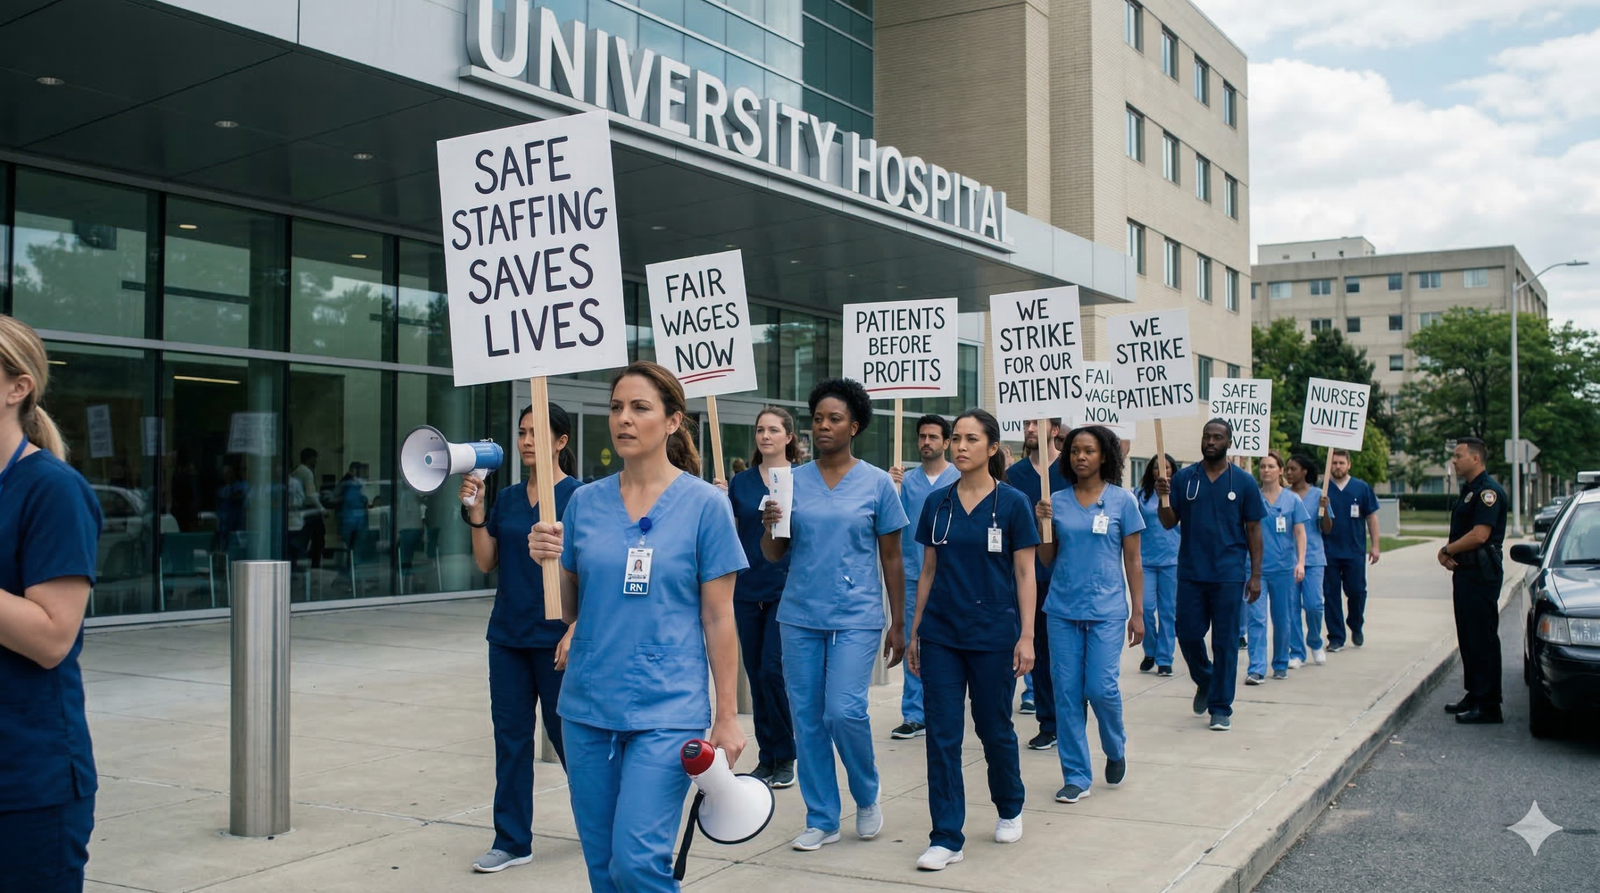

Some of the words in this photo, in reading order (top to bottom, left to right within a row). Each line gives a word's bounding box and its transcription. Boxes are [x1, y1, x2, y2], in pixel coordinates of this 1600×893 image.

[467, 0, 836, 182] UNIVERSITY
[848, 131, 1014, 245] HOSPITAL
[475, 136, 571, 195] SAFE
[452, 187, 607, 251] STAFFING
[469, 243, 594, 305] SAVES
[666, 268, 726, 303] FAIR
[660, 302, 739, 337] WAGES
[856, 306, 945, 334] PATIENTS
[1016, 298, 1050, 321] WE
[485, 298, 604, 357] LIVES
[1000, 321, 1076, 352] STRIKE
[1130, 317, 1162, 337] WE
[675, 338, 735, 373] NOW
[868, 334, 932, 356] BEFORE
[1116, 337, 1185, 365] STRIKE
[863, 358, 941, 384] PROFITS
[1004, 356, 1035, 375] FOR
[1040, 352, 1073, 371] OUR
[1136, 365, 1168, 383] FOR
[1085, 369, 1114, 385] FAI
[998, 375, 1083, 404] PATIENTS
[1117, 383, 1194, 410] PATIENTS
[1222, 383, 1258, 399] SAFE
[1311, 385, 1366, 408] NURSES
[1085, 406, 1119, 424] NOW
[1211, 400, 1268, 416] STAFFING
[1309, 407, 1360, 430] UNITE
[1227, 418, 1261, 433] AVES
[1232, 435, 1260, 451] VES
[629, 583, 643, 592] RN
